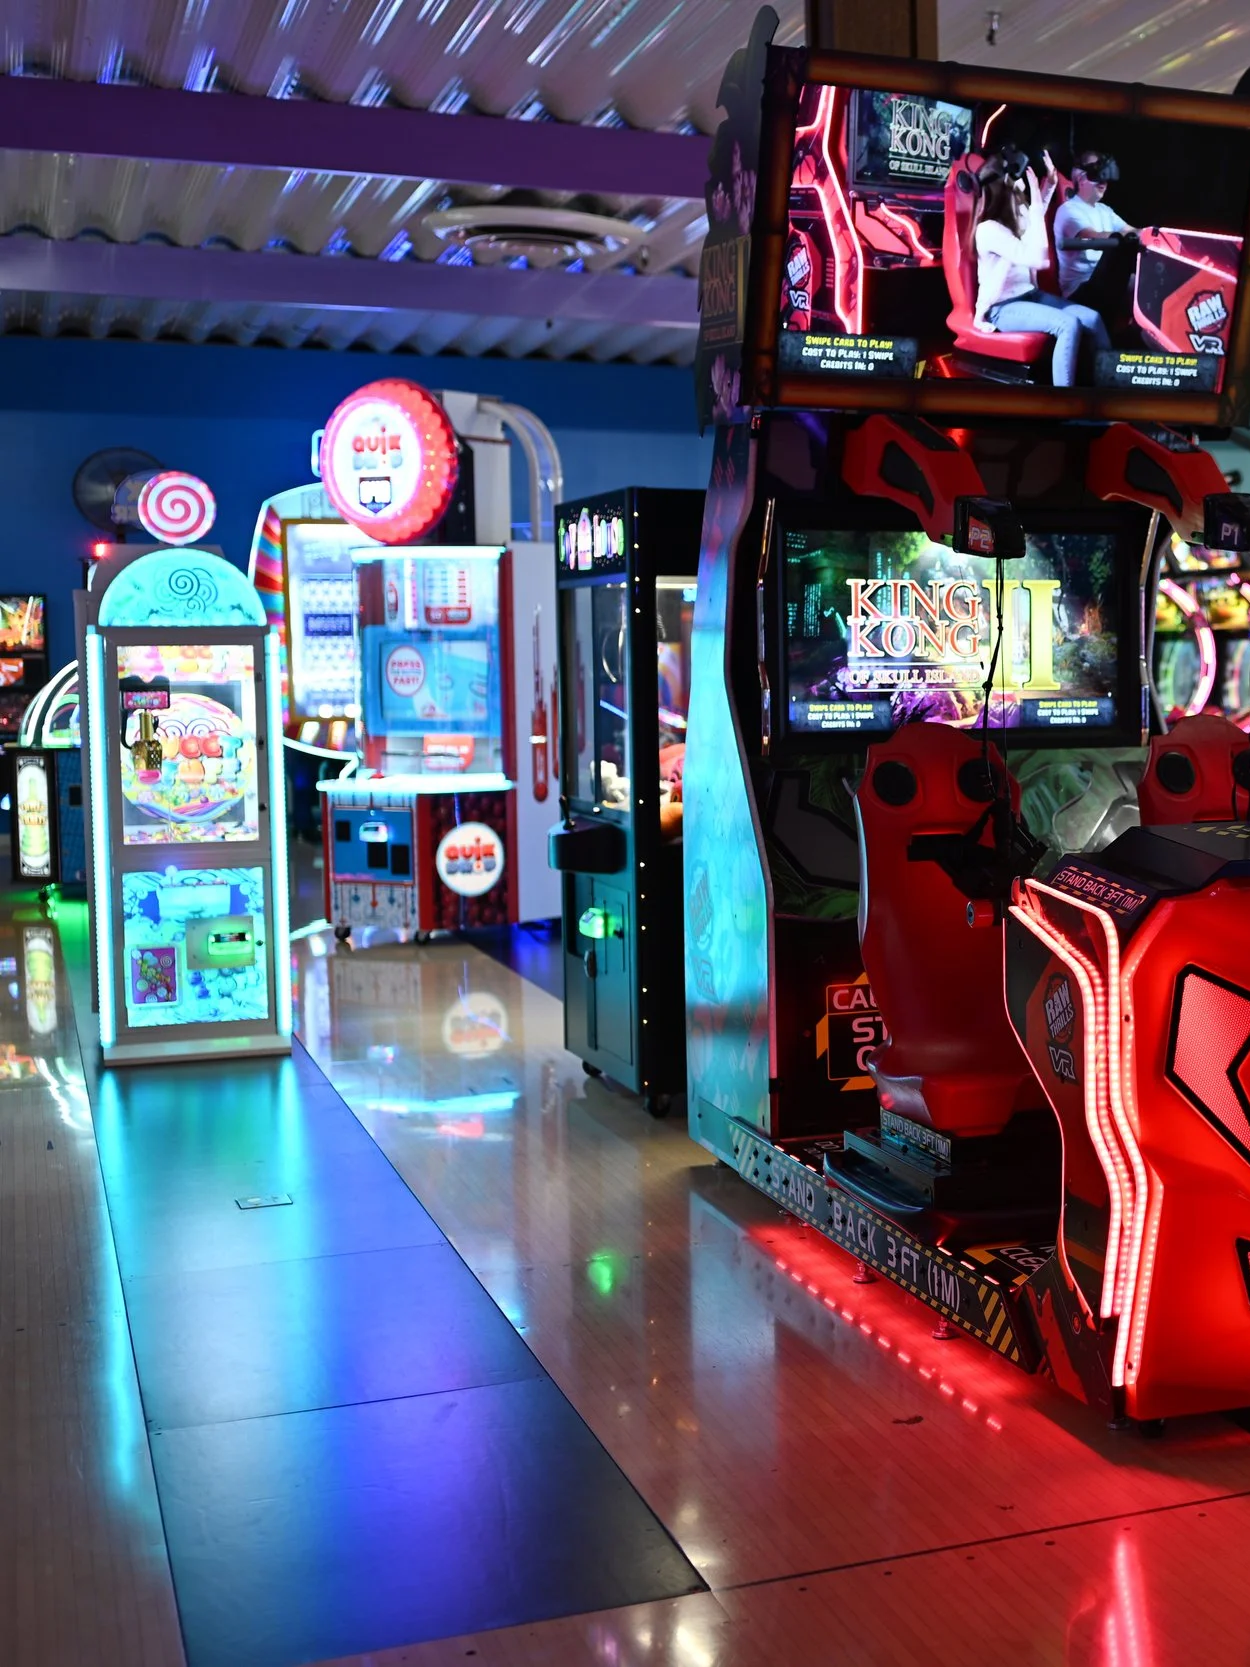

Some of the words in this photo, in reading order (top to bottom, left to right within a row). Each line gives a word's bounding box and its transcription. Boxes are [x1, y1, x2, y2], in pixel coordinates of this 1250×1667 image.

[890, 98, 952, 139] KING
[889, 124, 951, 160] KONG
[789, 290, 811, 311] VR
[1187, 293, 1222, 322] RAW
[1189, 334, 1225, 355] VR
[971, 529, 991, 550] P2
[1221, 526, 1240, 546] P1
[846, 578, 982, 622] KING
[847, 618, 981, 658] KONG
[982, 579, 1061, 691] II
[849, 669, 870, 685] OF
[873, 669, 923, 684] SKULL
[926, 668, 981, 684] ISLAND
[1057, 870, 1087, 889] STAND
[1083, 880, 1108, 898] BACK
[1104, 889, 1124, 904] 3FT
[1045, 980, 1070, 1025] RAW
[1049, 1003, 1074, 1038] THRILLS
[1049, 1046, 1076, 1079] VR
[882, 1113, 904, 1133] STAND
[904, 1121, 921, 1142] BACK
[922, 1132, 935, 1150] 3FT
[770, 1162, 816, 1213] STAND
[832, 1197, 877, 1257] BACK
[927, 1259, 961, 1314] (1M)
